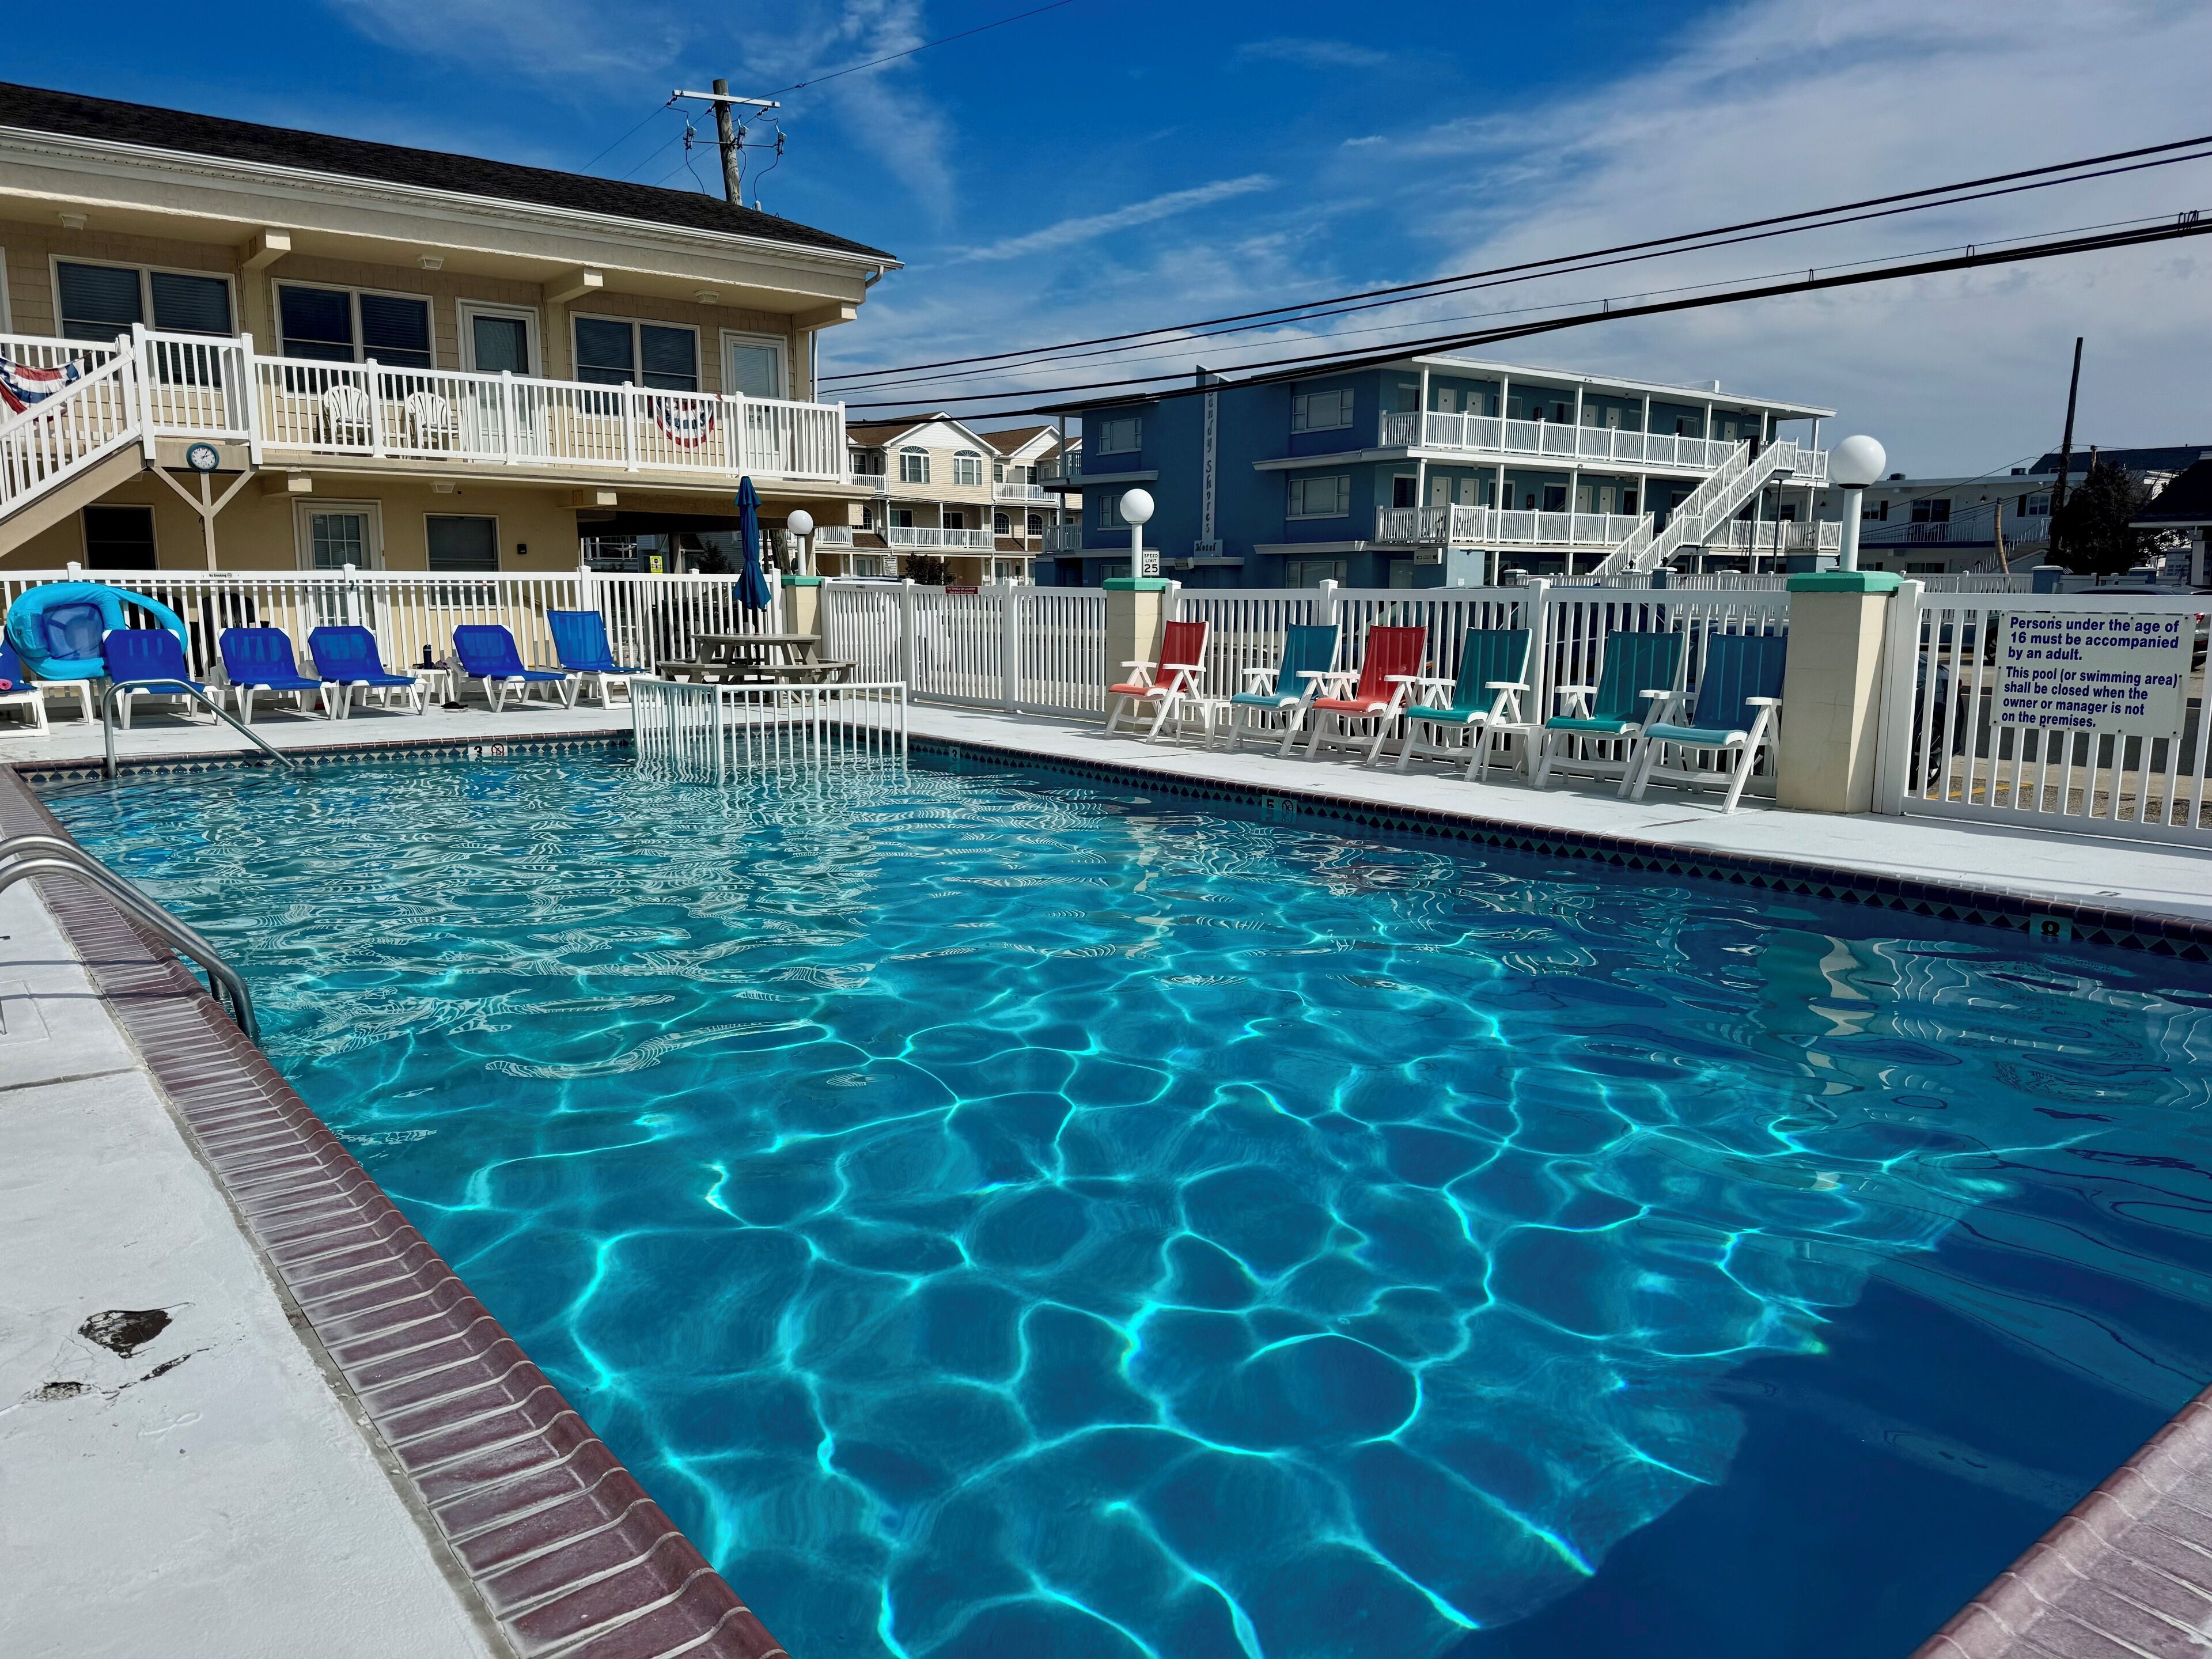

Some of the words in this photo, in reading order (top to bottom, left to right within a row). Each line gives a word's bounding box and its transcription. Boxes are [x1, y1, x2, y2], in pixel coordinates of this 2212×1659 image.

[1195, 541, 1217, 551] Motel
[1144, 564, 1158, 573] 25
[2010, 616, 2062, 629] Persons
[2066, 618, 2105, 630] under
[2109, 619, 2130, 631] the
[2135, 622, 2160, 634] age
[2165, 620, 2179, 632] of
[2011, 631, 2026, 643] 16
[2031, 633, 2062, 645] must
[2066, 633, 2081, 645] be
[2085, 635, 2179, 650] accompanied
[2008, 646, 2023, 660] by
[2027, 650, 2041, 658] an
[2046, 648, 2082, 660] adult.
[2006, 666, 2029, 678] This
[2032, 668, 2056, 681] pool
[2061, 669, 2077, 683] (or
[2080, 671, 2141, 687] swimming
[2145, 673, 2177, 688] area)
[2004, 681, 2031, 693] shall
[2034, 682, 2047, 694] be
[2051, 683, 2089, 696] closed
[2093, 685, 2124, 698] when
[2128, 687, 2147, 700] the
[2003, 698, 2038, 708] owner
[2041, 700, 2052, 709] or
[2056, 701, 2108, 714] manager
[2111, 702, 2121, 714] is
[2125, 704, 2144, 715] not
[2002, 713, 2014, 721] on
[2018, 711, 2036, 723] the
[2039, 714, 2096, 728] premises.
[474, 745, 483, 755] 3
[1267, 798, 1274, 808] 5
